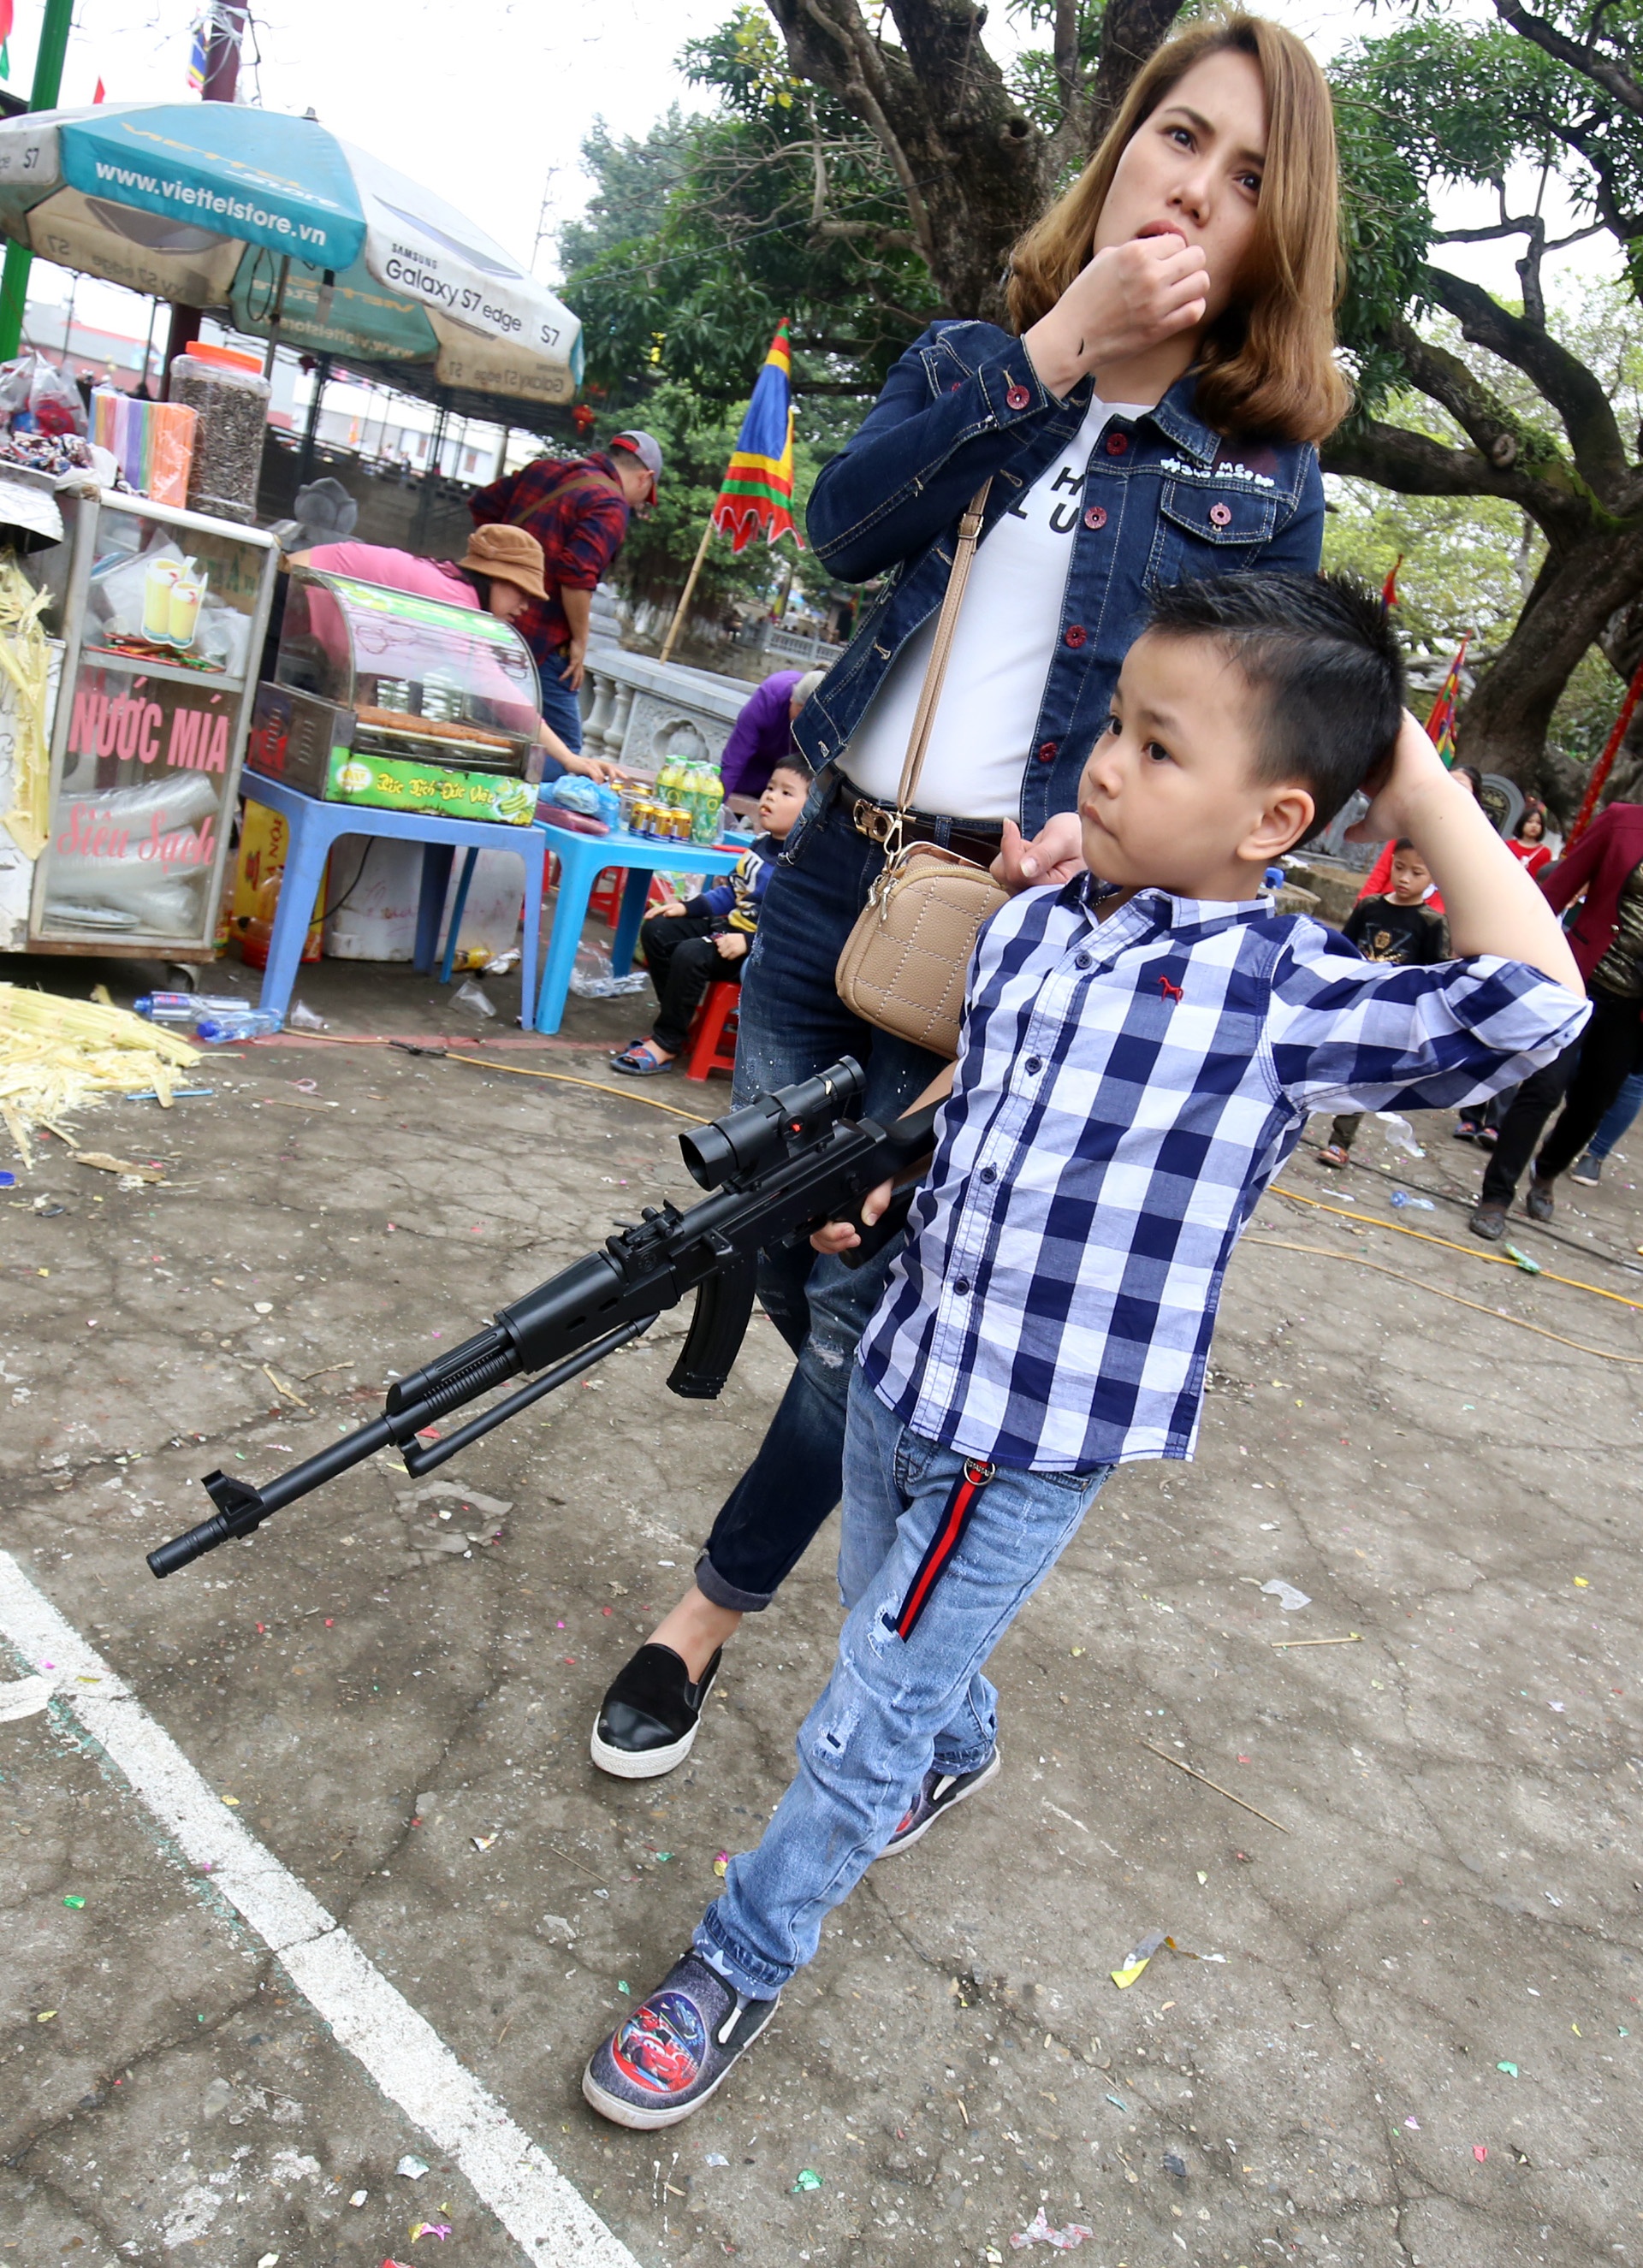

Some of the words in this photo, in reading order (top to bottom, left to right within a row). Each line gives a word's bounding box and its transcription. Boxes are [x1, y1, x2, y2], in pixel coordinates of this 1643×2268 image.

[22, 147, 39, 169] S7
[94, 161, 327, 246] www.viettelstore.vn
[391, 242, 439, 270] SAMSUNG
[385, 258, 460, 307] Galaxy
[460, 288, 483, 313] S7
[482, 304, 523, 333] edge
[539, 323, 561, 347] S7
[68, 675, 163, 765] NƯỚC
[56, 802, 131, 859] Siêu
[137, 809, 216, 875] Sạch
